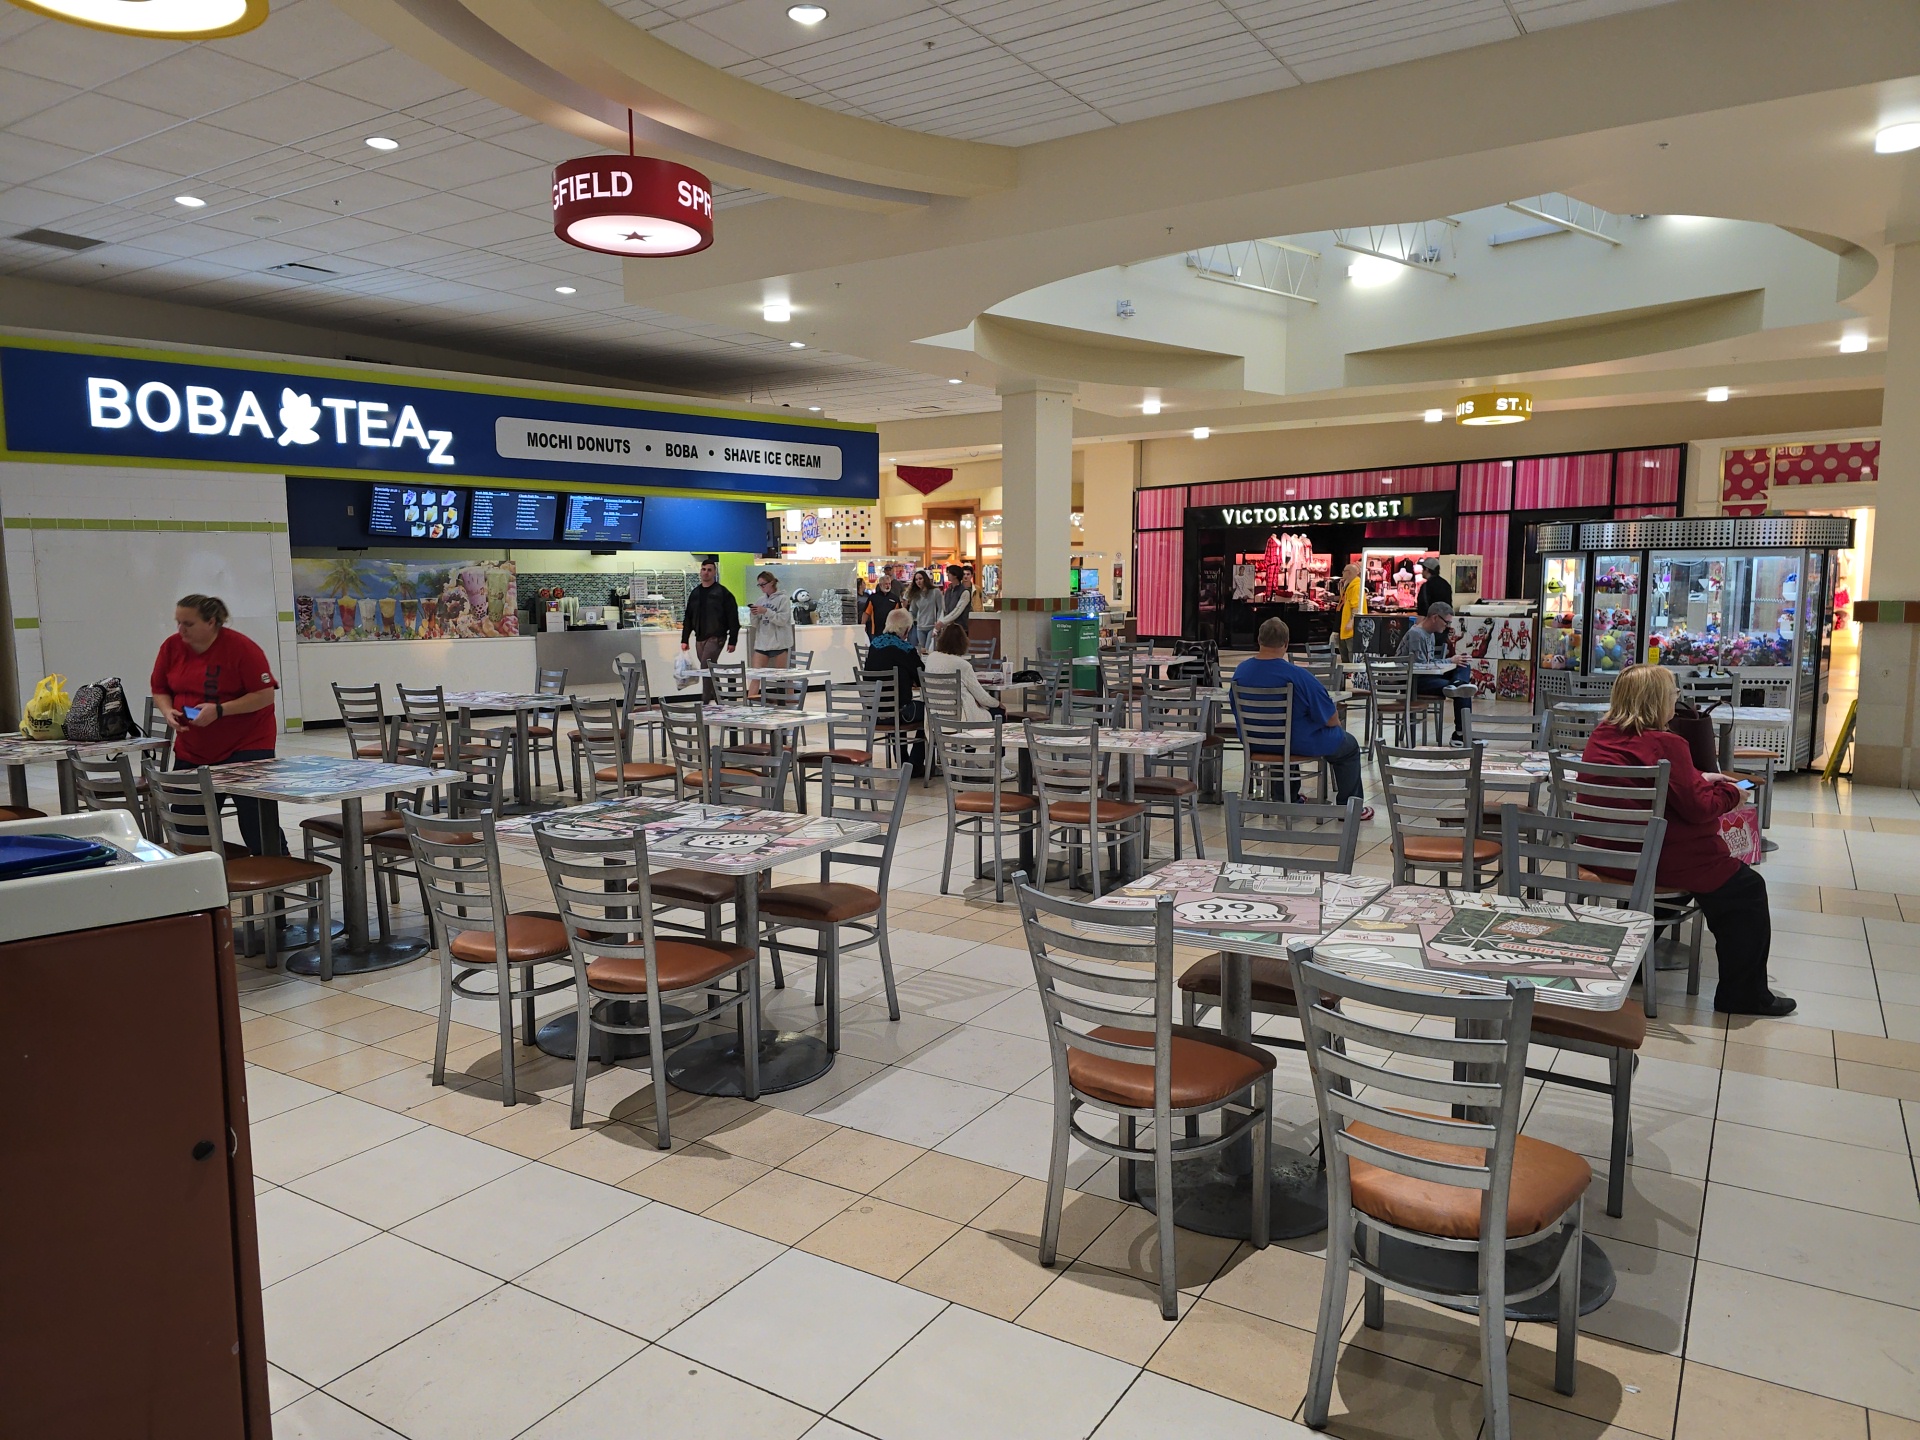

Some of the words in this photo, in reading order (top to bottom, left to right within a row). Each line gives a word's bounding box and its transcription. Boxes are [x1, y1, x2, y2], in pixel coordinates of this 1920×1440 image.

[86, 376, 274, 440] BOBA
[1496, 397, 1523, 411] ST.
[526, 431, 574, 451] MOCHI
[576, 435, 631, 454] DONUTS
[664, 442, 699, 459] BOBA
[723, 446, 761, 464] SHAVE
[764, 450, 782, 466] ICE
[785, 451, 822, 469] CREAM
[1222, 503, 1323, 526] VICTORIA'S
[1329, 499, 1402, 521] SECRET
[1723, 828, 1747, 841] Bath
[704, 839, 749, 847] 66
[1196, 902, 1256, 914] 66
[1191, 912, 1278, 922] ROUTE
[1559, 949, 1606, 962] SANTA
